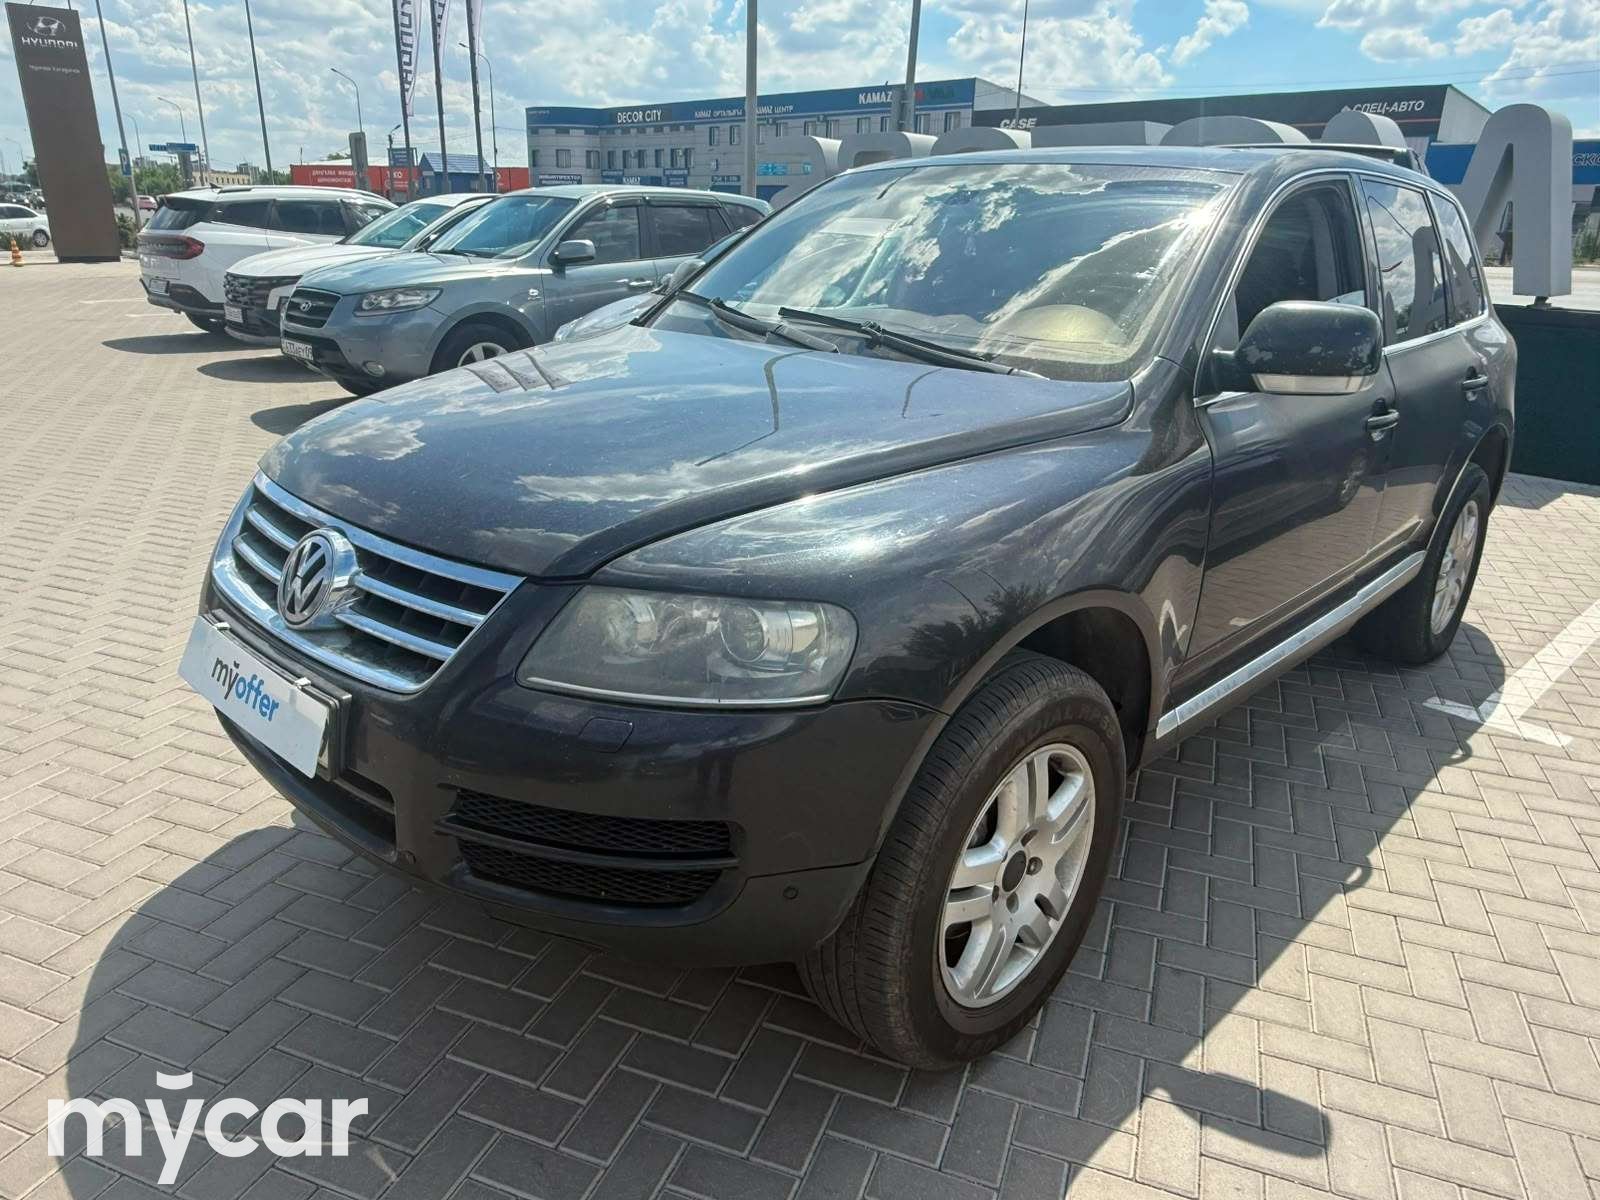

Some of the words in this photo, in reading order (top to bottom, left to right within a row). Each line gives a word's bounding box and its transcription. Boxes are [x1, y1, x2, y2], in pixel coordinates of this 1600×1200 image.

[21, 36, 78, 49] HYUNDAI
[858, 90, 893, 105] KAMAZ
[1351, 99, 1425, 114] СПЕЦ-АВТО
[617, 111, 642, 123] DECOR
[644, 109, 662, 121] CITY
[1000, 118, 1037, 130] CASE
[211, 656, 280, 722] myoffer
